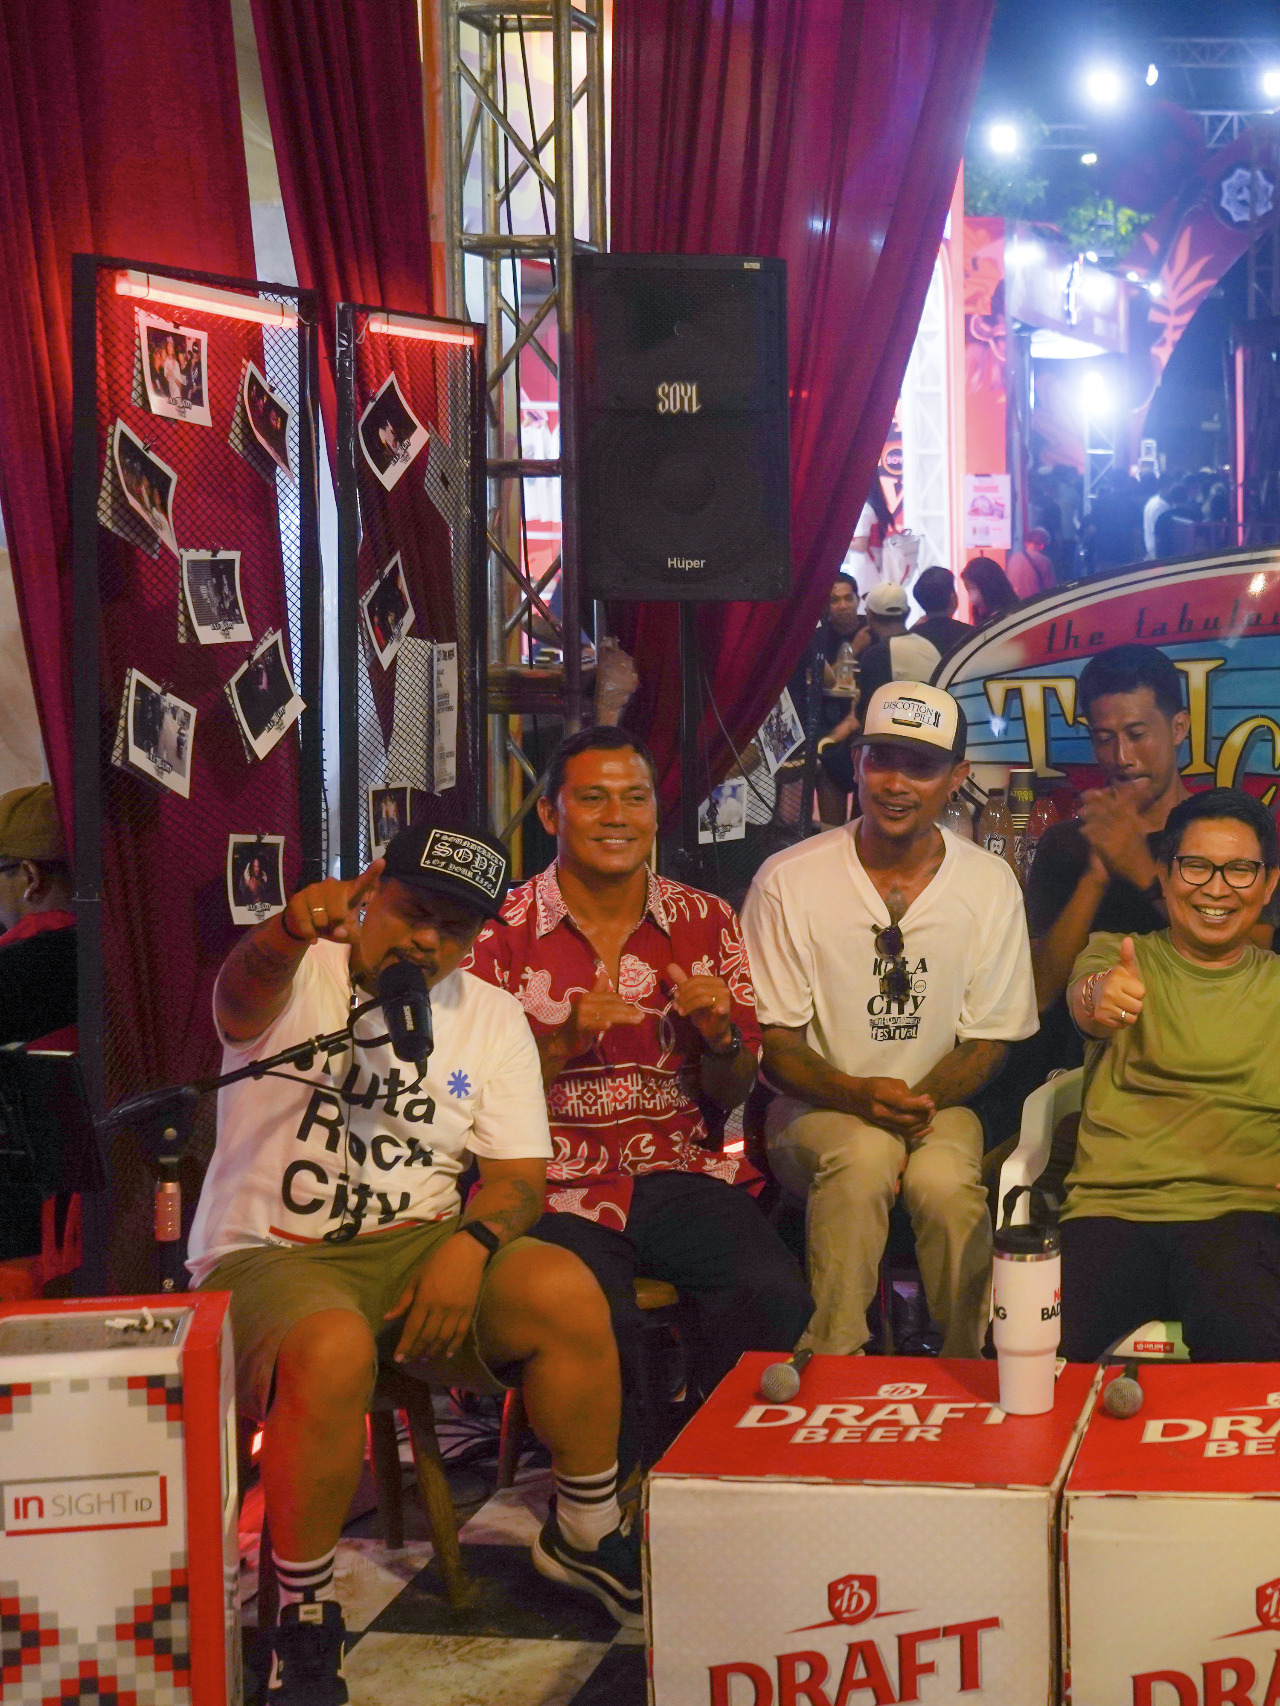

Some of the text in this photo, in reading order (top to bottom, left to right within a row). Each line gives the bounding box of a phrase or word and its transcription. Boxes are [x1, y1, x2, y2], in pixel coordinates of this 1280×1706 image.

[656, 382, 701, 414] SOYL
[667, 556, 706, 571] Hüper
[1043, 619, 1105, 655] the
[883, 701, 934, 717] DISCOTION
[913, 712, 932, 726] PILL
[403, 1005, 415, 1031] SHURE
[321, 1043, 437, 1125] uta
[734, 1402, 1007, 1429] DRAFT
[788, 1426, 944, 1445] BEER
[51, 1490, 134, 1518] SIGHT
